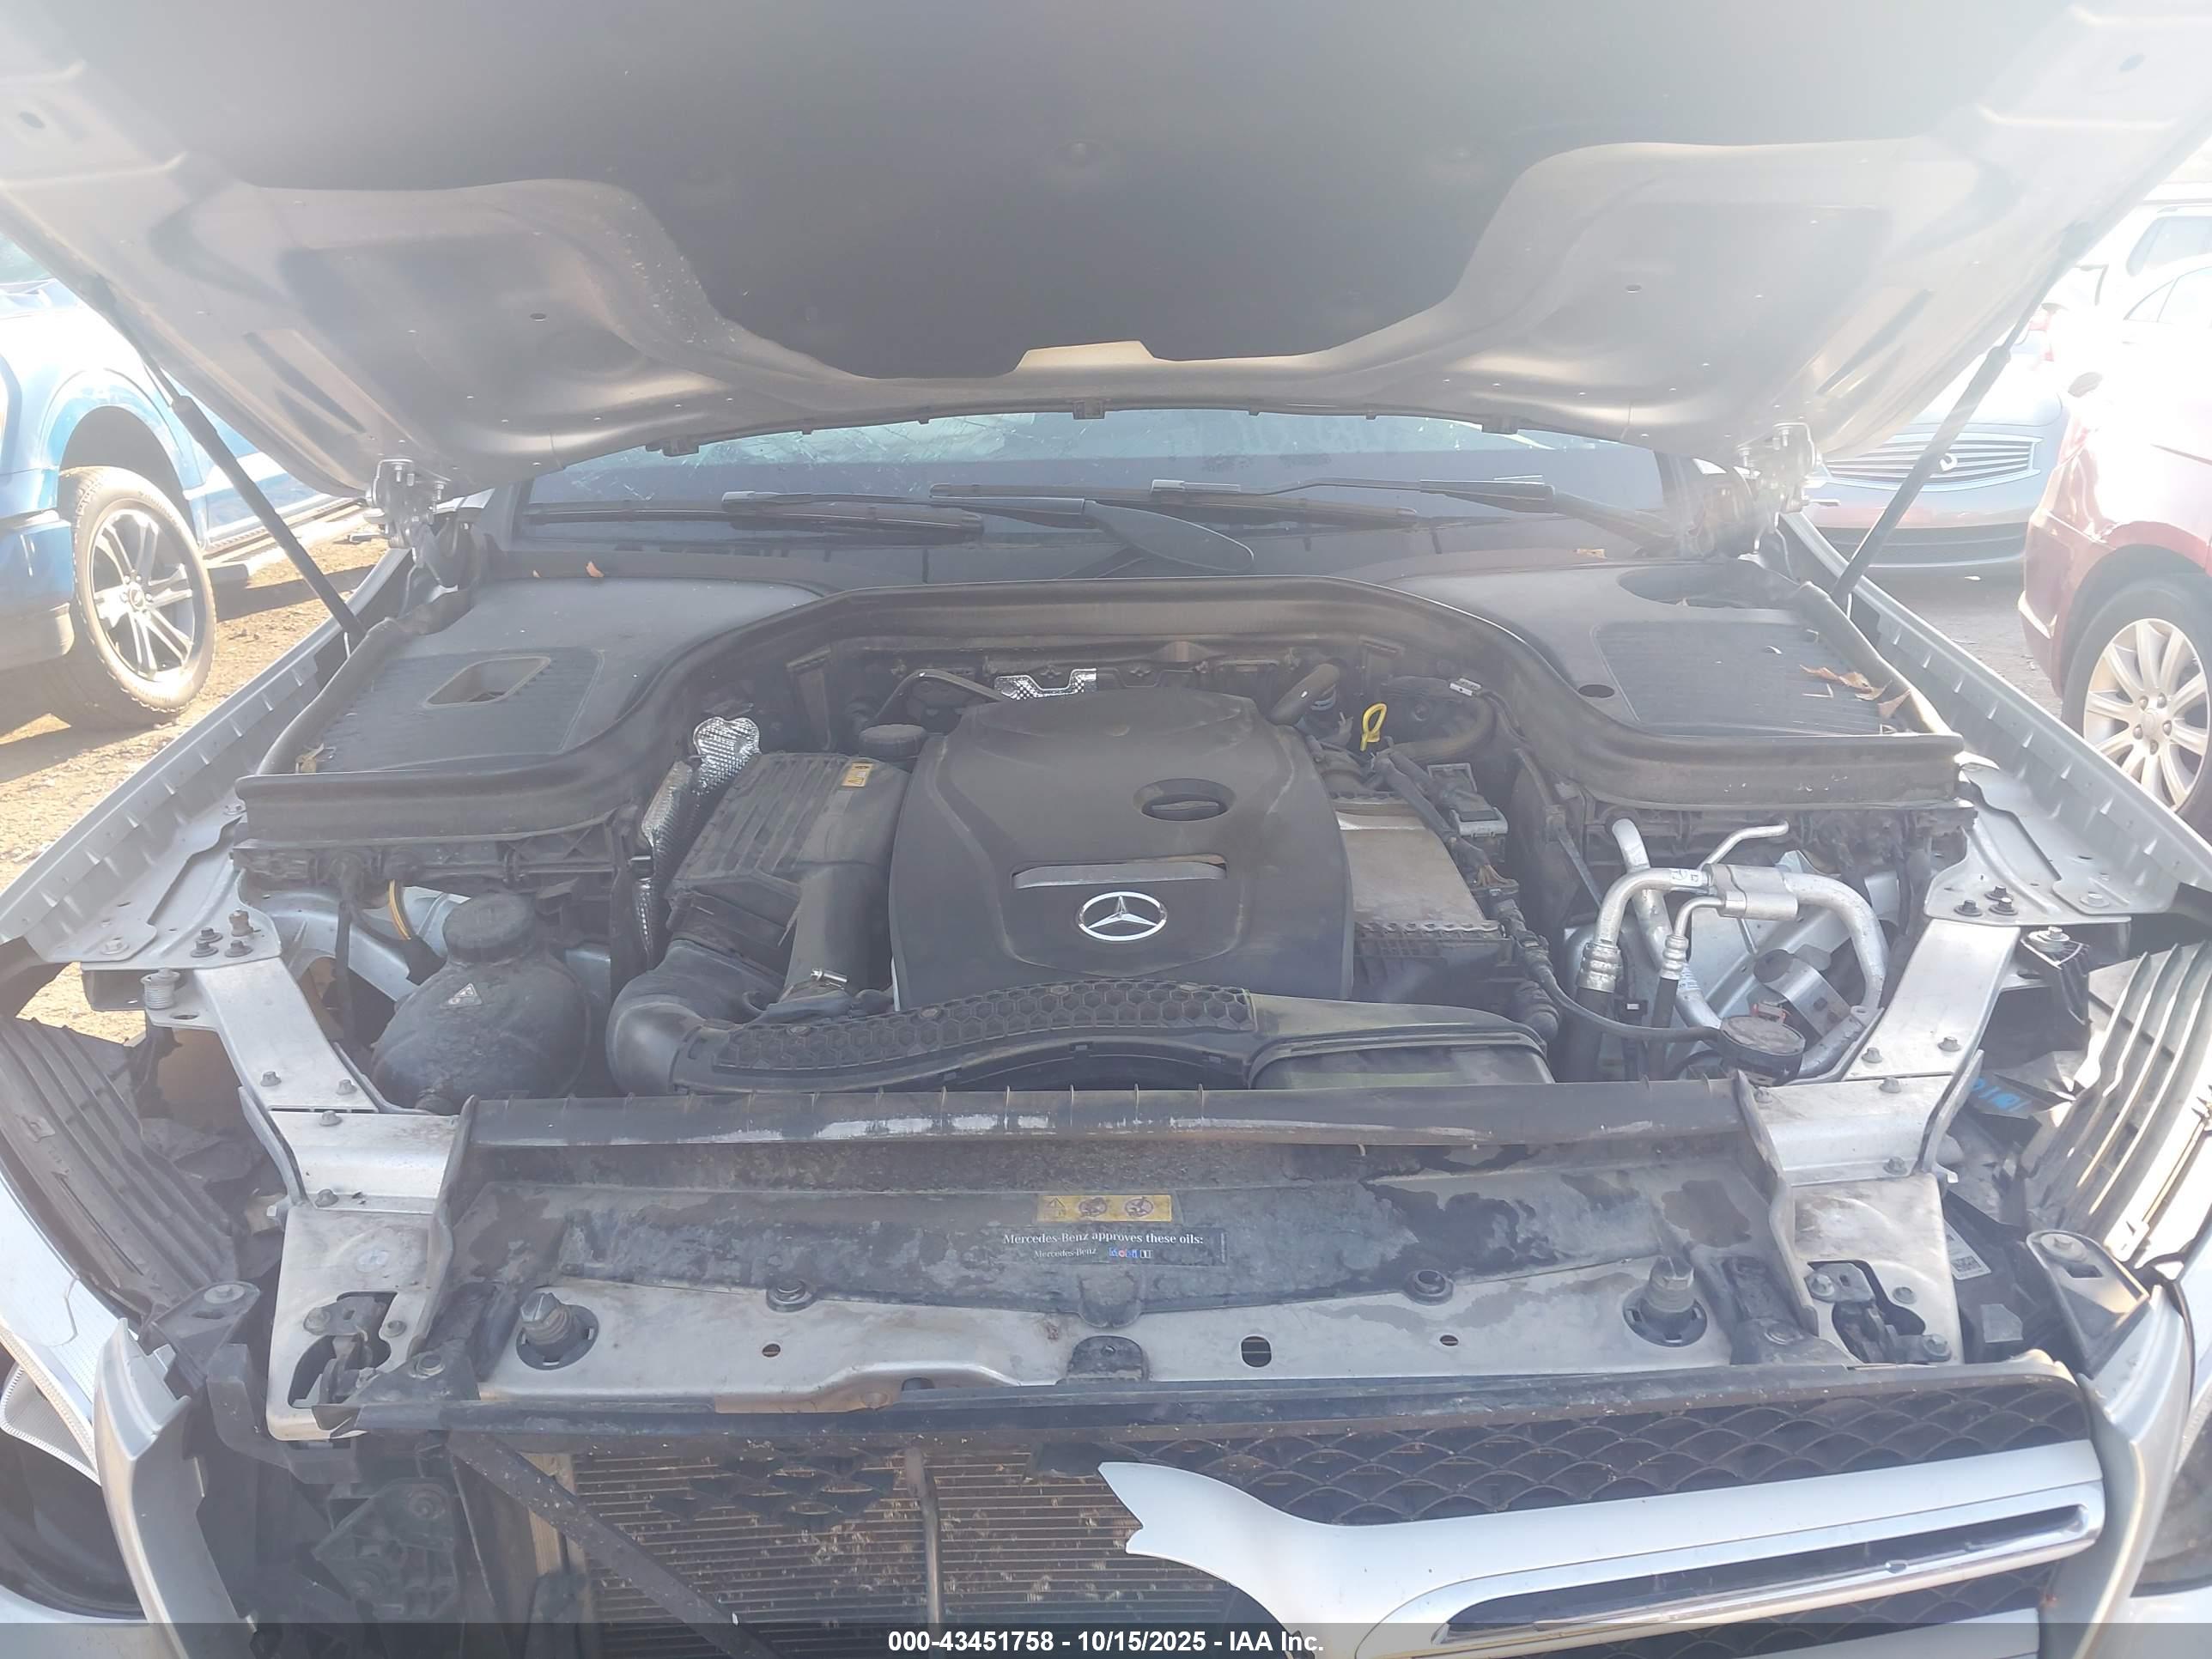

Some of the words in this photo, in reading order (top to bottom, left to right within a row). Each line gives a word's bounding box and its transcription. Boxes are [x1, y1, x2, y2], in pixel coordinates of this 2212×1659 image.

[1003, 1232, 1089, 1244] Mercedes-Benz
[1091, 1231, 1143, 1243] approves
[1146, 1233, 1176, 1244] these
[1179, 1233, 1204, 1244] oils:
[1034, 1248, 1097, 1258] Mercedes-Benz
